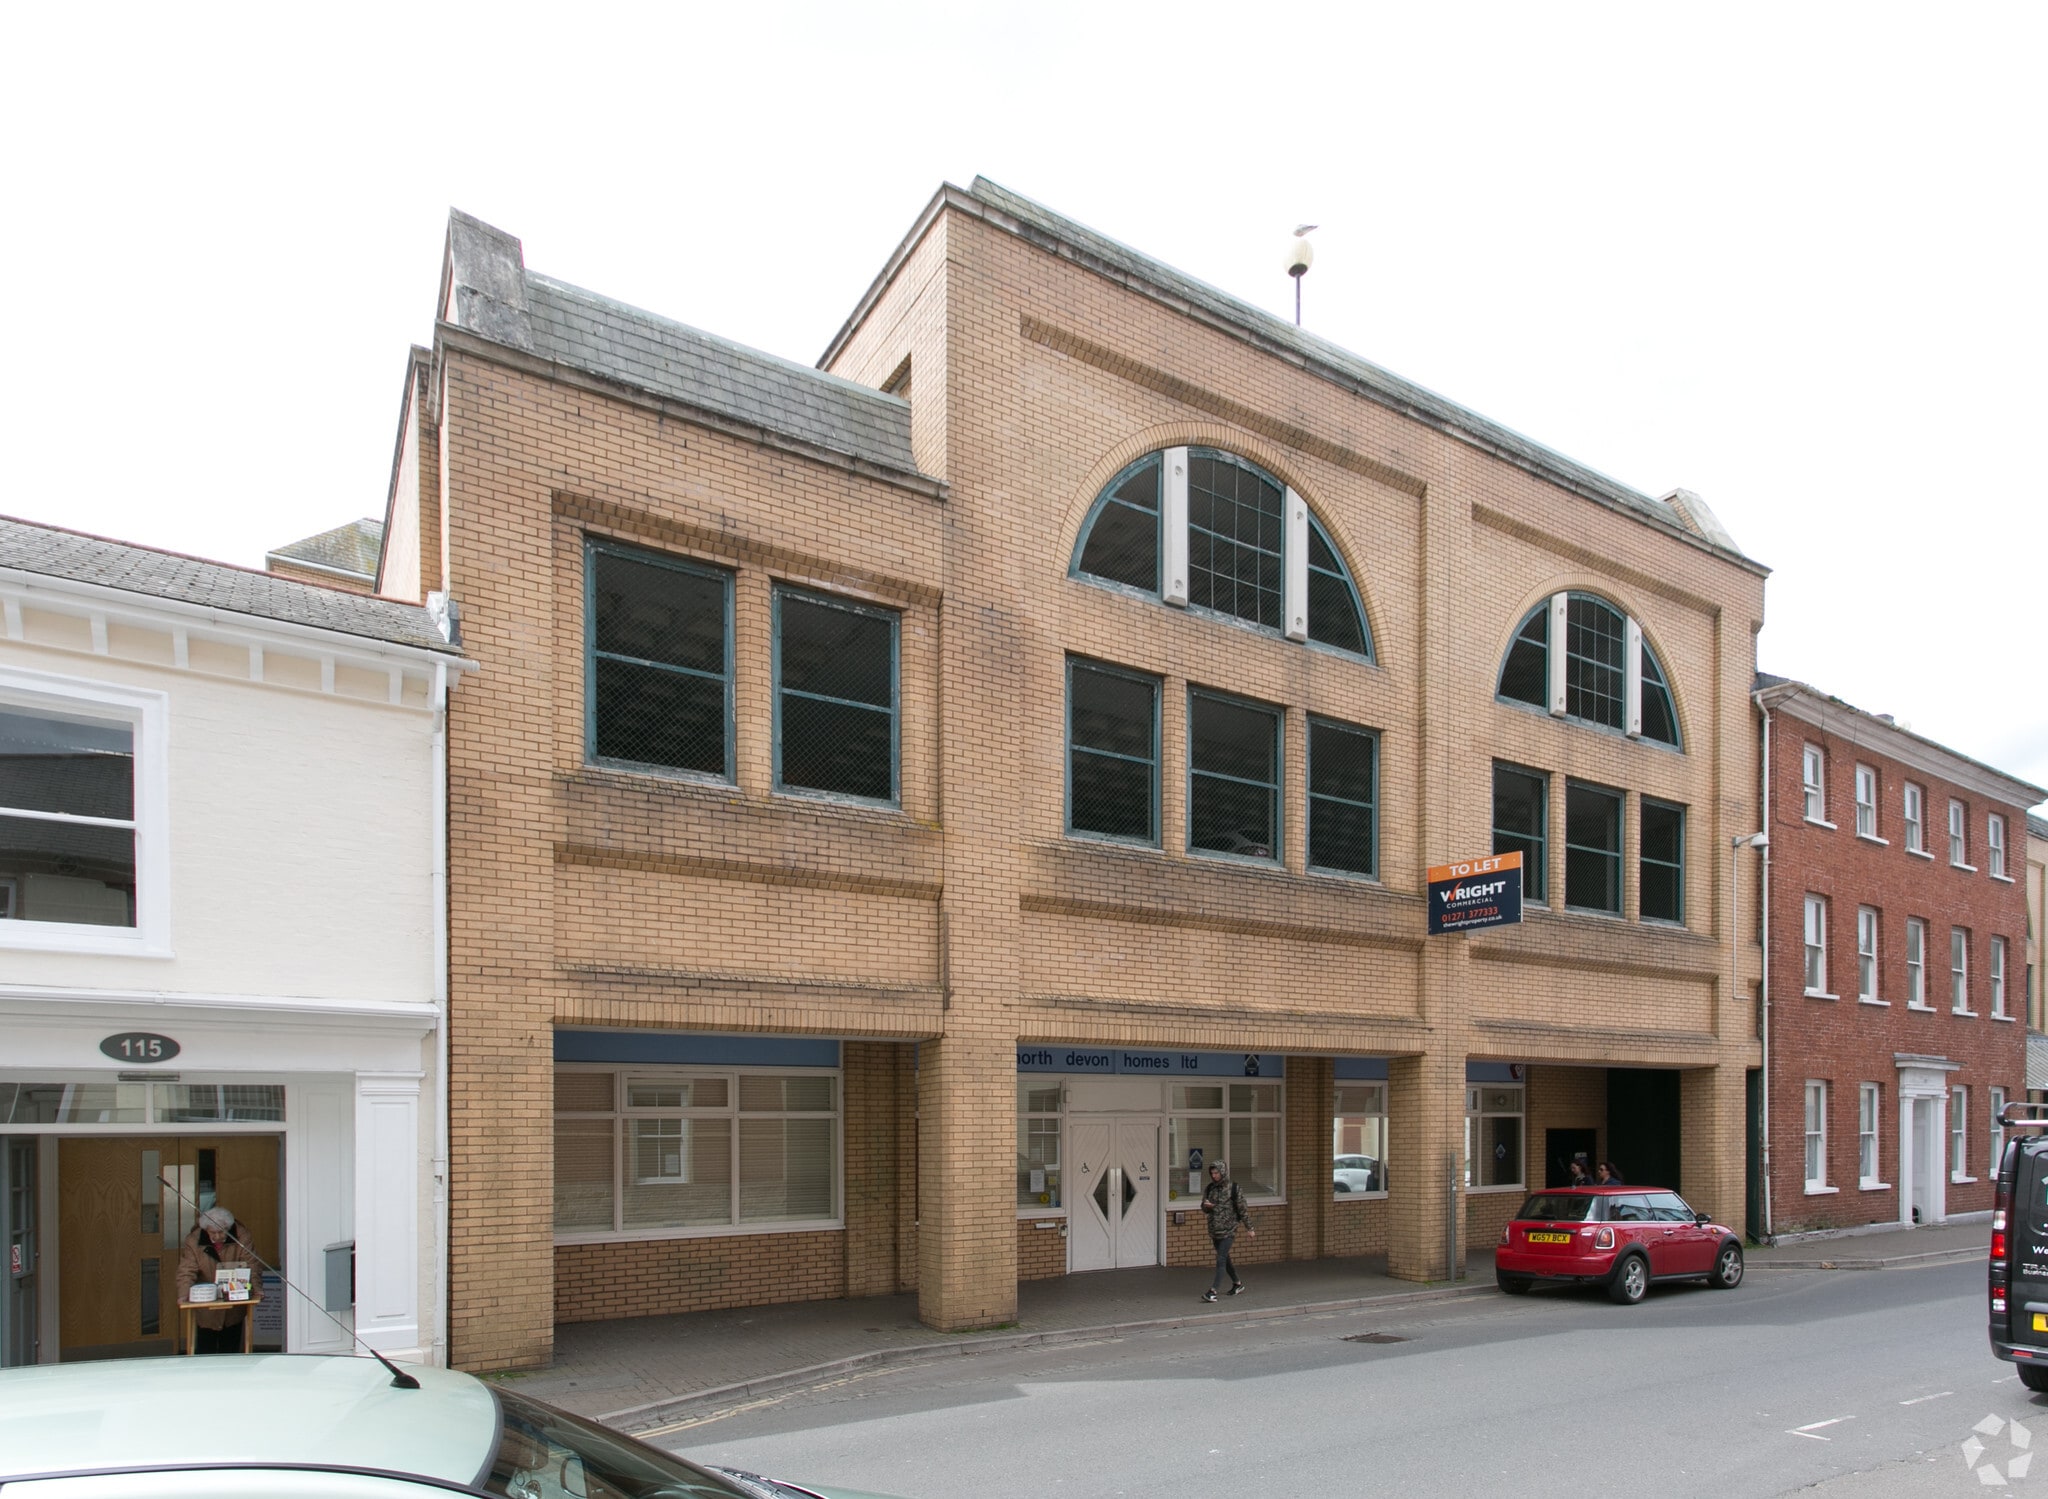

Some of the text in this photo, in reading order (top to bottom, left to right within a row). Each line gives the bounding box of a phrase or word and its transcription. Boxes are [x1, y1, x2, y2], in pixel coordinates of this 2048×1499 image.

[1449, 858, 1502, 876] TO LET
[1440, 881, 1506, 902] WRIGHT
[1446, 897, 1493, 909] COMMERCIAL
[1442, 906, 1498, 923] 01271 377333
[121, 1039, 162, 1057] 115
[1065, 1051, 1109, 1066] devon
[1123, 1053, 1170, 1068] homes
[1181, 1055, 1198, 1069] ltd
